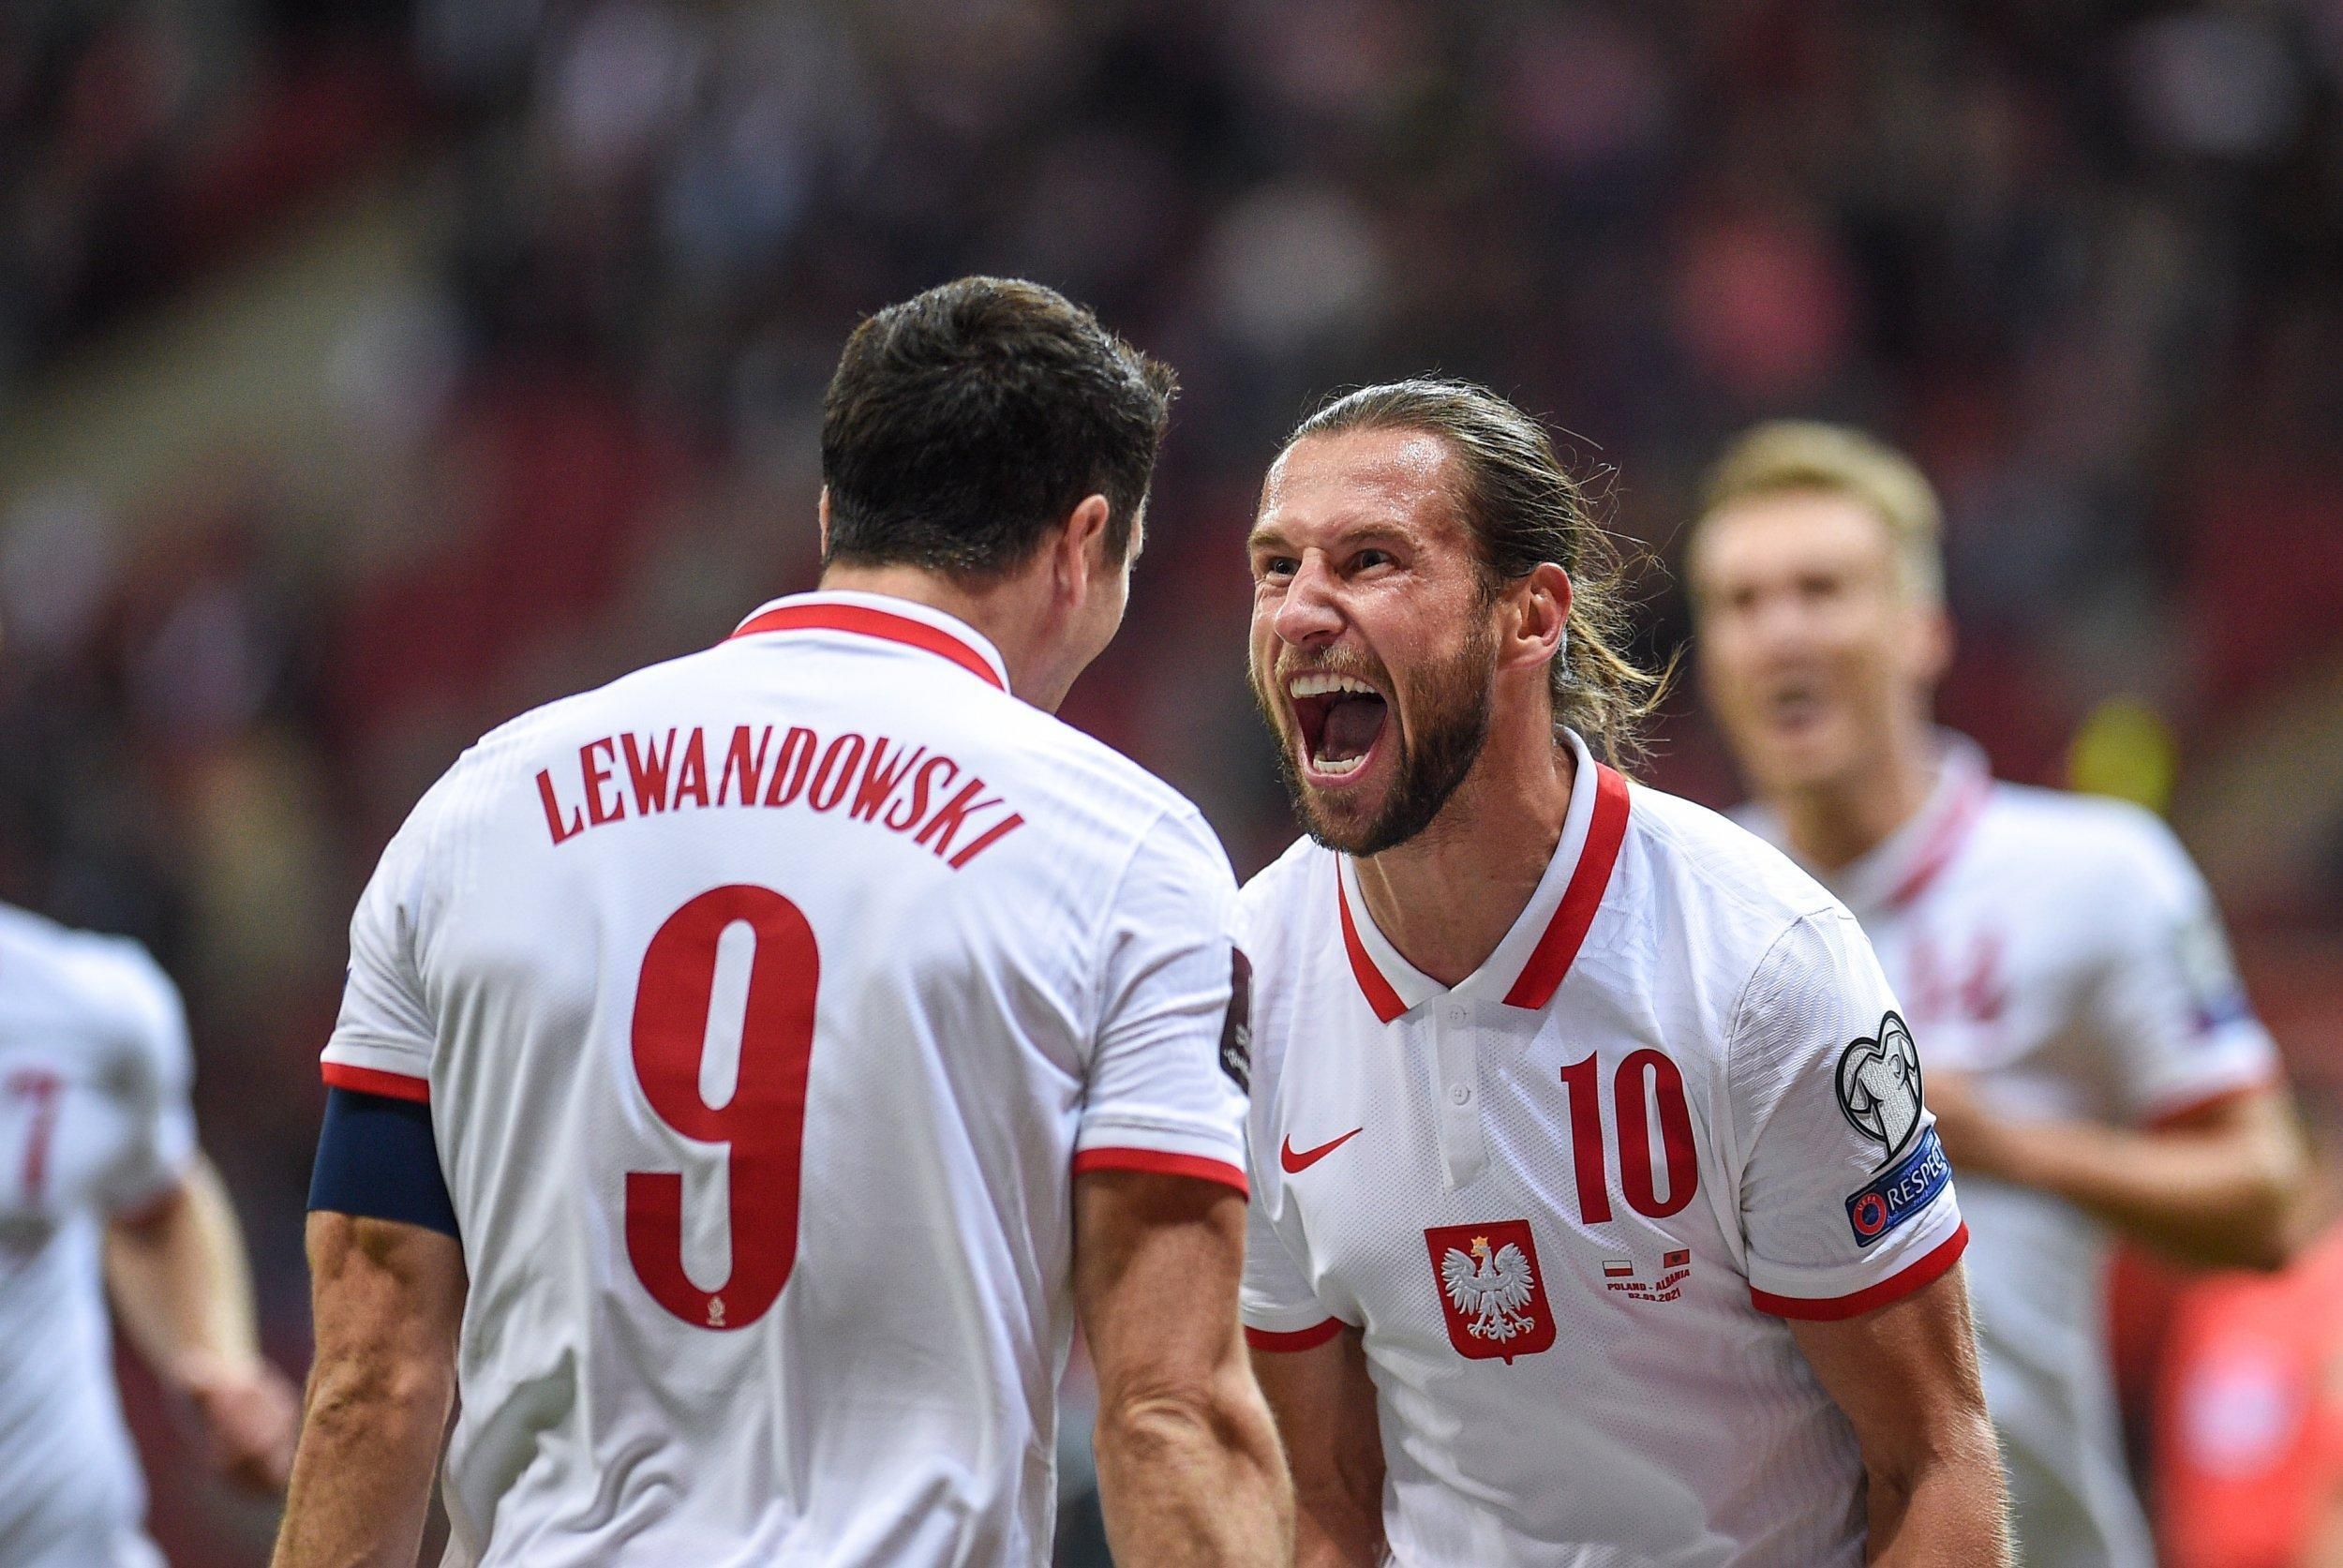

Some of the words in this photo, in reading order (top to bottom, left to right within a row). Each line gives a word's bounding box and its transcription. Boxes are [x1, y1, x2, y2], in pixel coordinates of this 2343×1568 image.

[535, 724, 1025, 871] LEWANDOWSKI
[625, 884, 820, 1332] 9
[1560, 1048, 1698, 1225] 10
[1888, 1143, 1947, 1211] RESPEC
[1606, 1282, 1647, 1291] POLAND
[1655, 1269, 1691, 1292] ALBANIA
